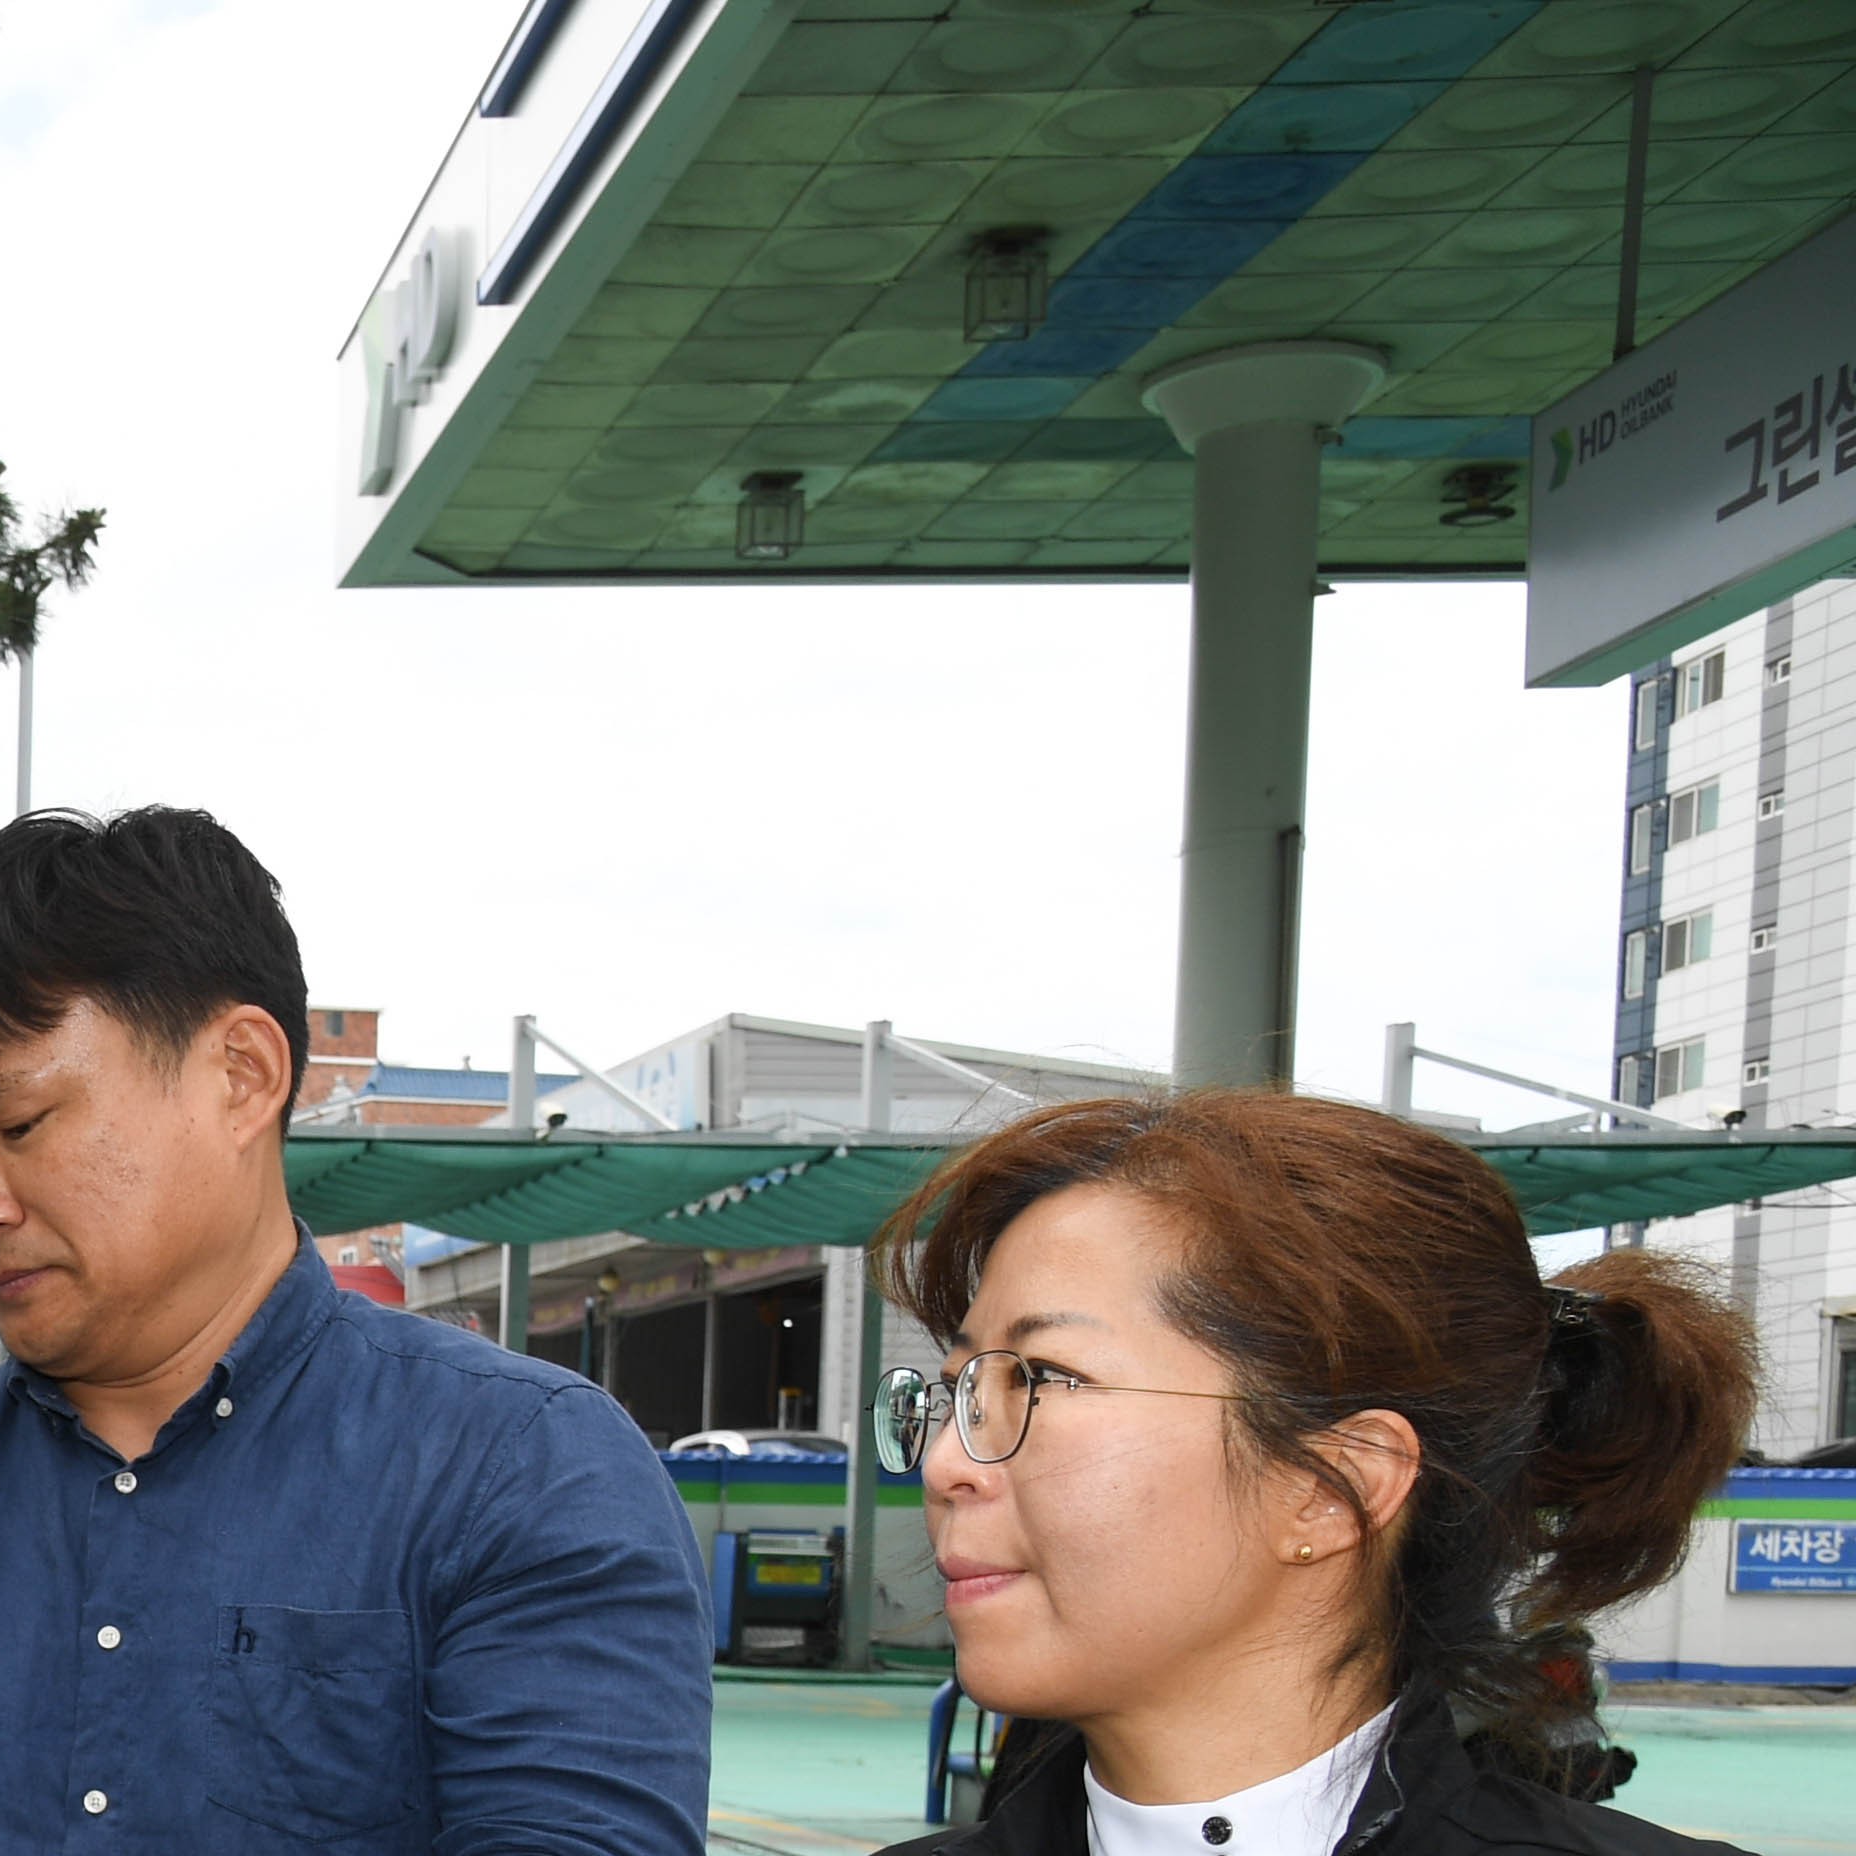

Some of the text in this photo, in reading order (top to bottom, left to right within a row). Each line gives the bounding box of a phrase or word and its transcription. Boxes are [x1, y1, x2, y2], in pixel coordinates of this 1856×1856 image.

[1621, 369, 1677, 418] HYUNDAI
[1578, 409, 1616, 465] HD
[1749, 1528, 1845, 1564] 세차장
